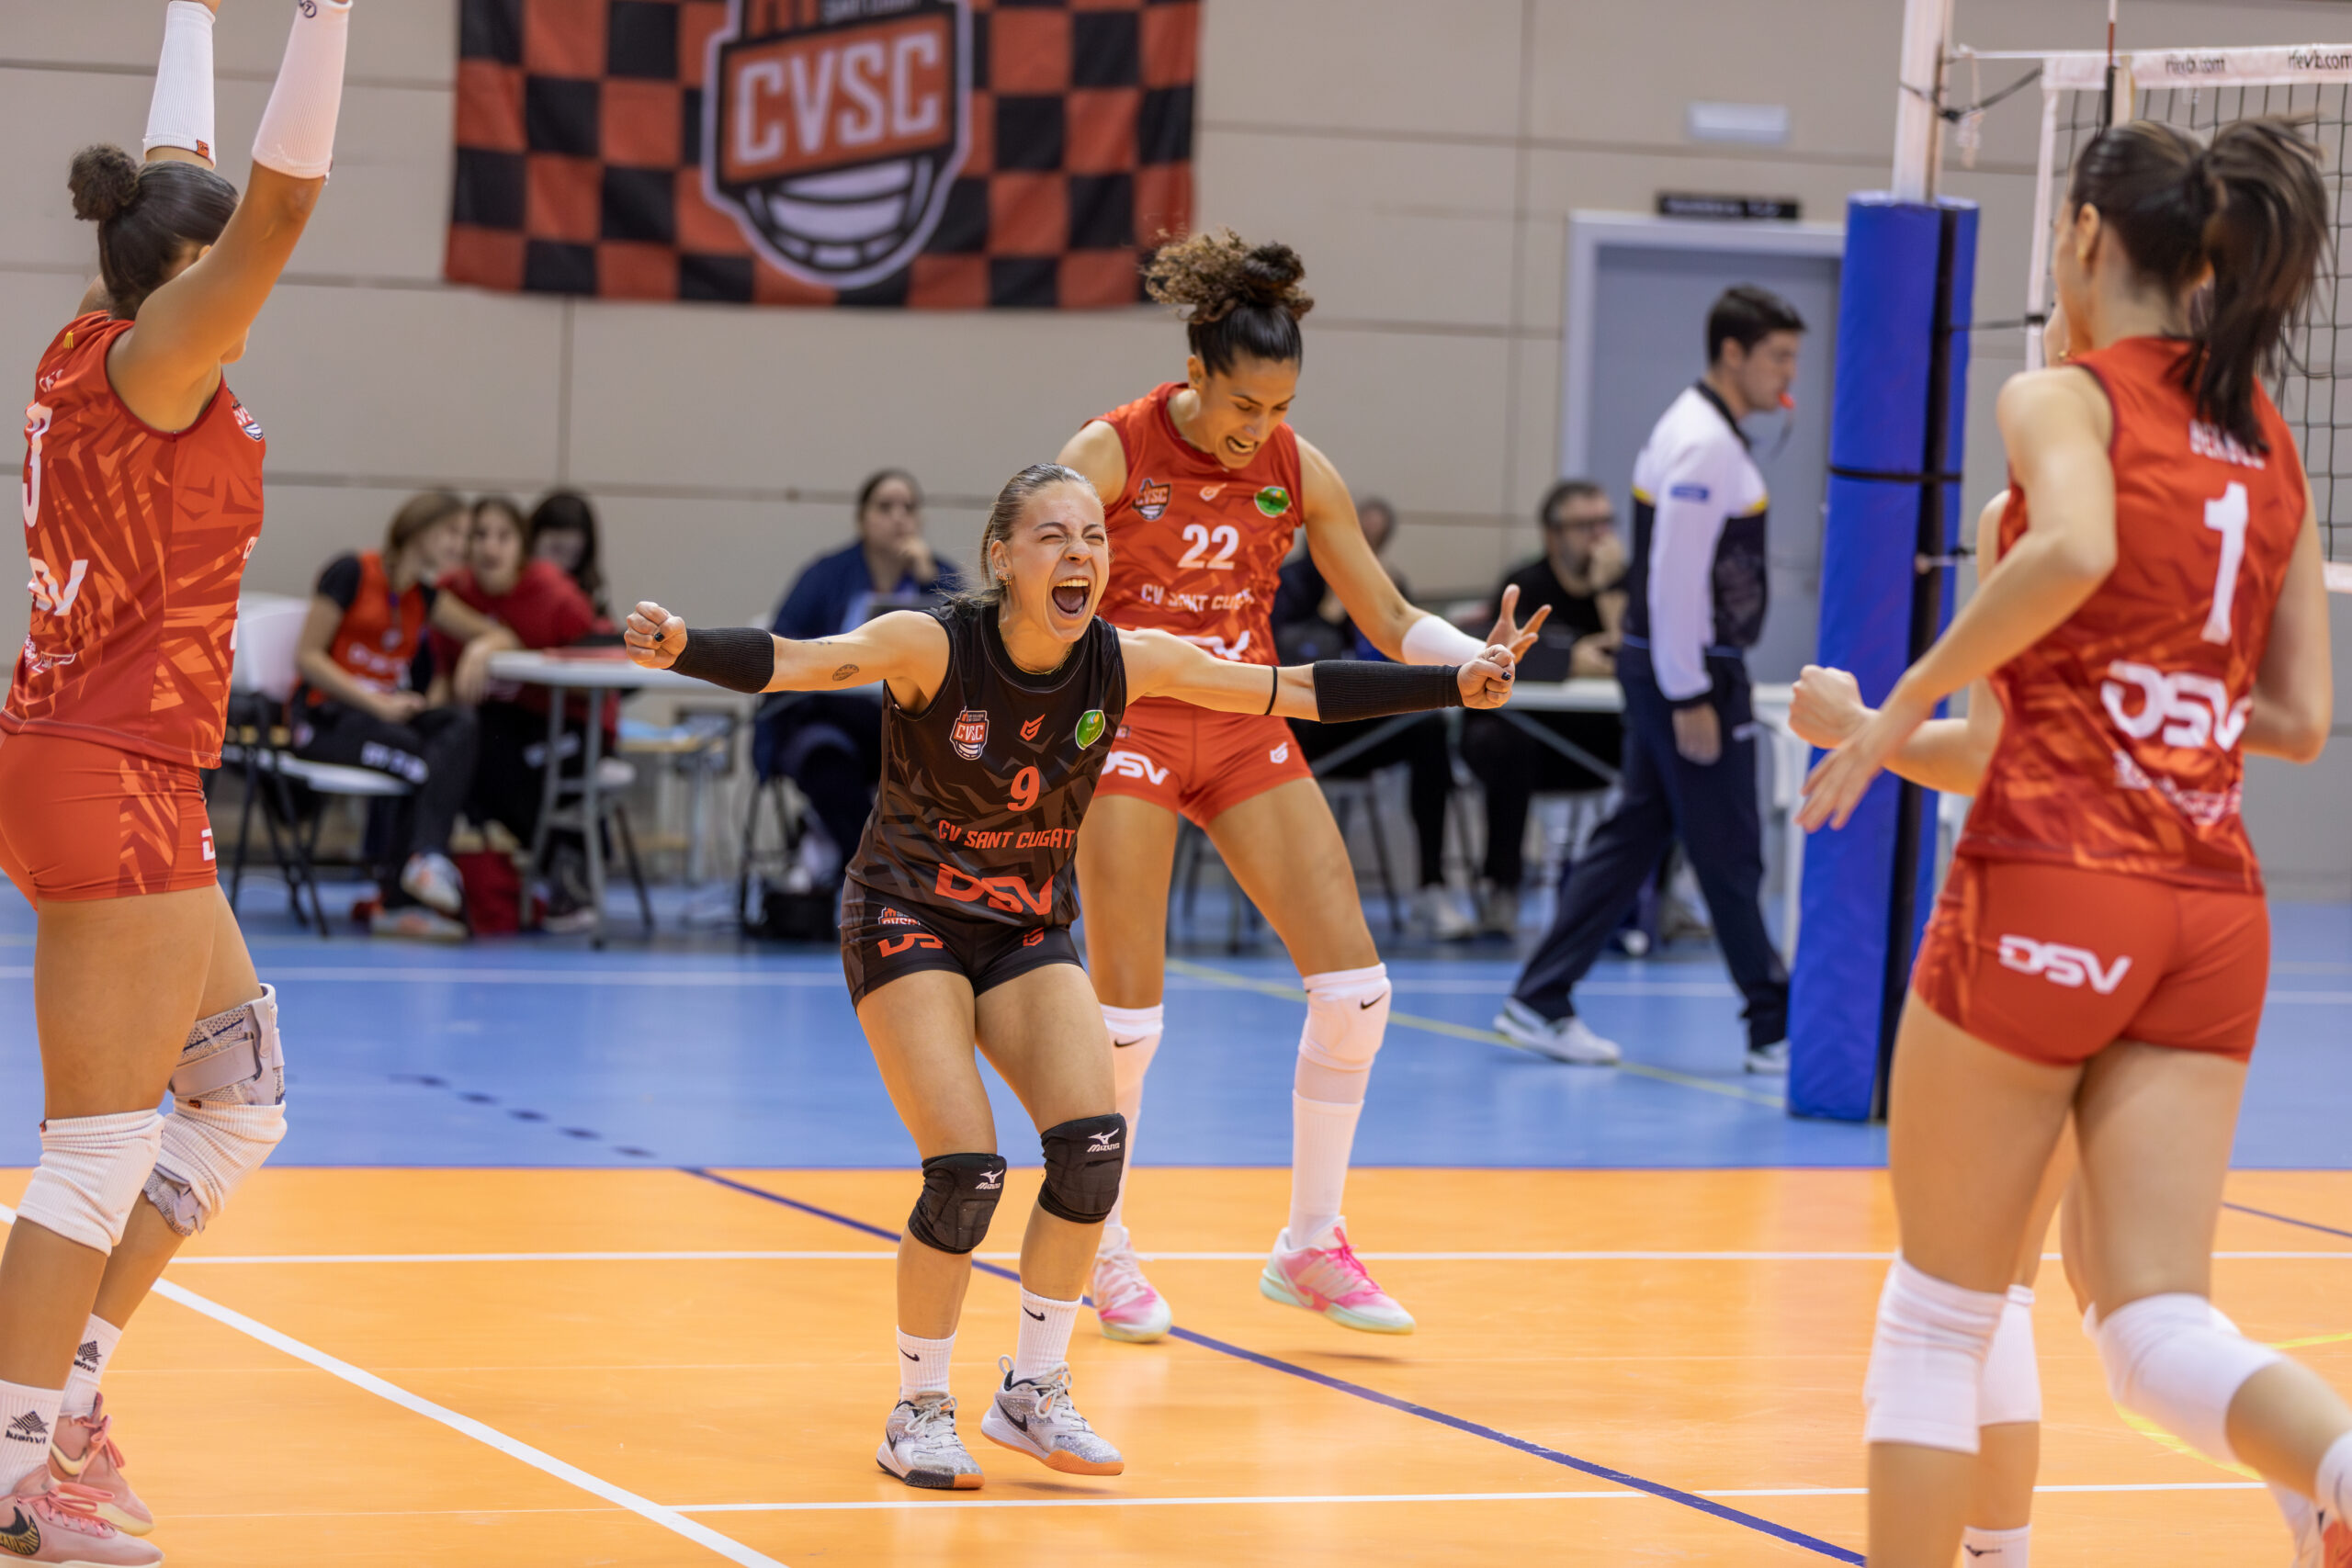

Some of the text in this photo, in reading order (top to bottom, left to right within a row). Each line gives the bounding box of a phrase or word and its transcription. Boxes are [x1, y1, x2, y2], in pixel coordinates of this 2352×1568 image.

[736, 31, 942, 164] CVSC
[1177, 524, 1239, 570] 22
[2201, 480, 2249, 644] 1
[1141, 583, 1164, 604] CV
[2100, 660, 2254, 751] DSV
[956, 724, 984, 741] CVSC
[1007, 766, 1040, 811] 9
[938, 819, 1076, 849] CV SANT CUGAT
[934, 863, 1056, 916] DSV
[1997, 933, 2133, 996] DSV
